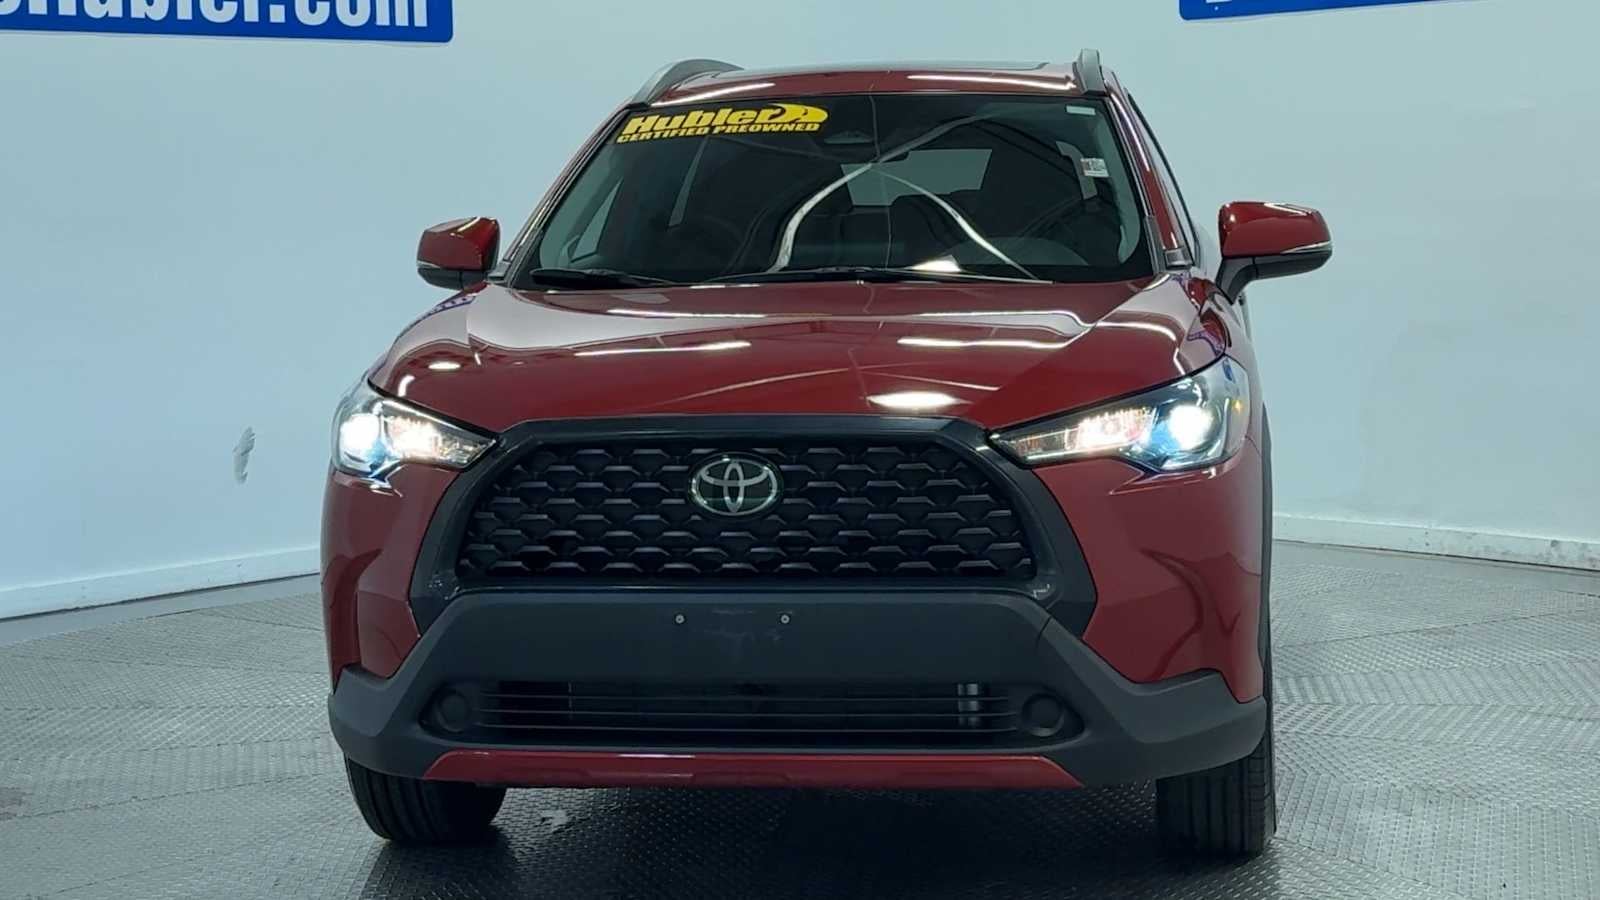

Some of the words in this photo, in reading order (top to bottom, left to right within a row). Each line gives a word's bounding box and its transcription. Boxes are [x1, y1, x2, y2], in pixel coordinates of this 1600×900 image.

[622, 107, 784, 134] Hubler
[616, 127, 709, 144] CERTIFIED
[712, 123, 821, 135] PREOWNED
